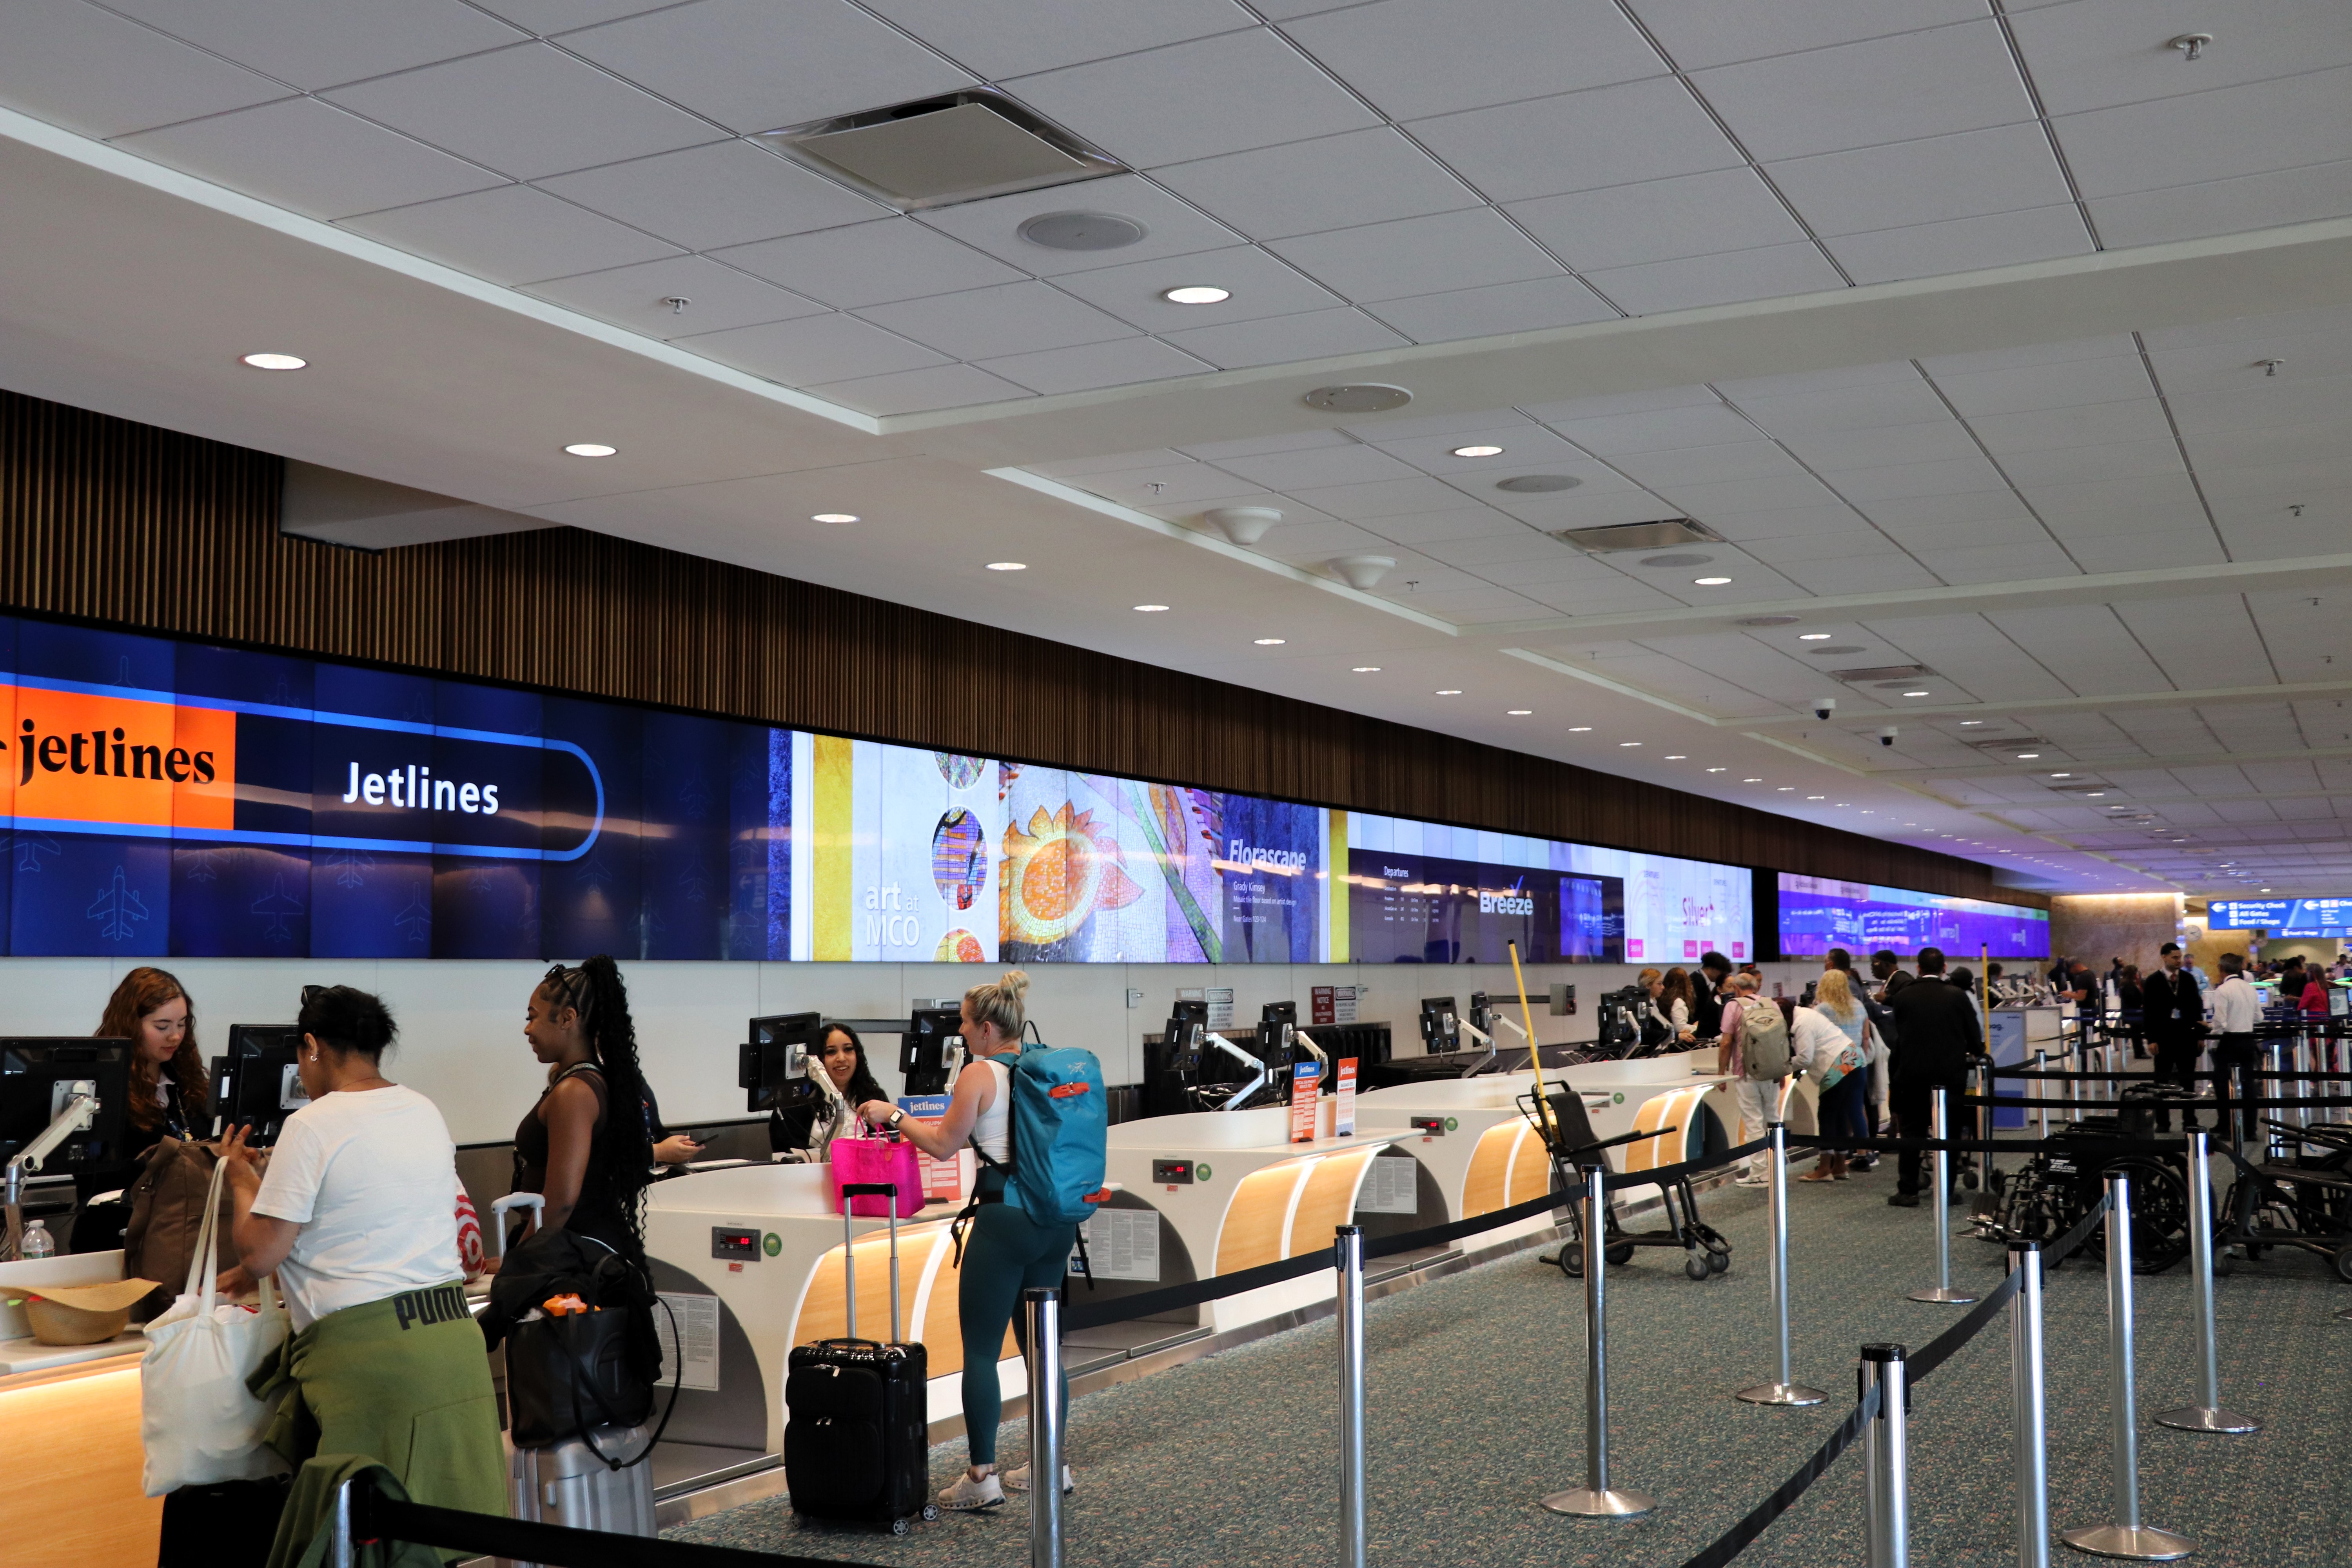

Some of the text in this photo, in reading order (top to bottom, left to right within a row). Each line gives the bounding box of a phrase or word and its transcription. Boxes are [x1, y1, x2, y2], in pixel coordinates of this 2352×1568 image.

[19, 719, 215, 787] jetlines
[343, 762, 499, 815] Jetlines
[1230, 839, 1307, 876] Florascape
[1384, 866, 1409, 878] Departures
[866, 881, 919, 911] art at
[1234, 881, 1265, 894] Grady Kimsey
[1480, 891, 1534, 915] Breeze
[1683, 896, 1708, 926] Silver
[866, 914, 921, 946] MCO
[1300, 1065, 1315, 1074] jetlines
[1341, 1065, 1355, 1077] jetlines
[910, 1101, 945, 1113] jetlines
[394, 1286, 472, 1330] PUMA
